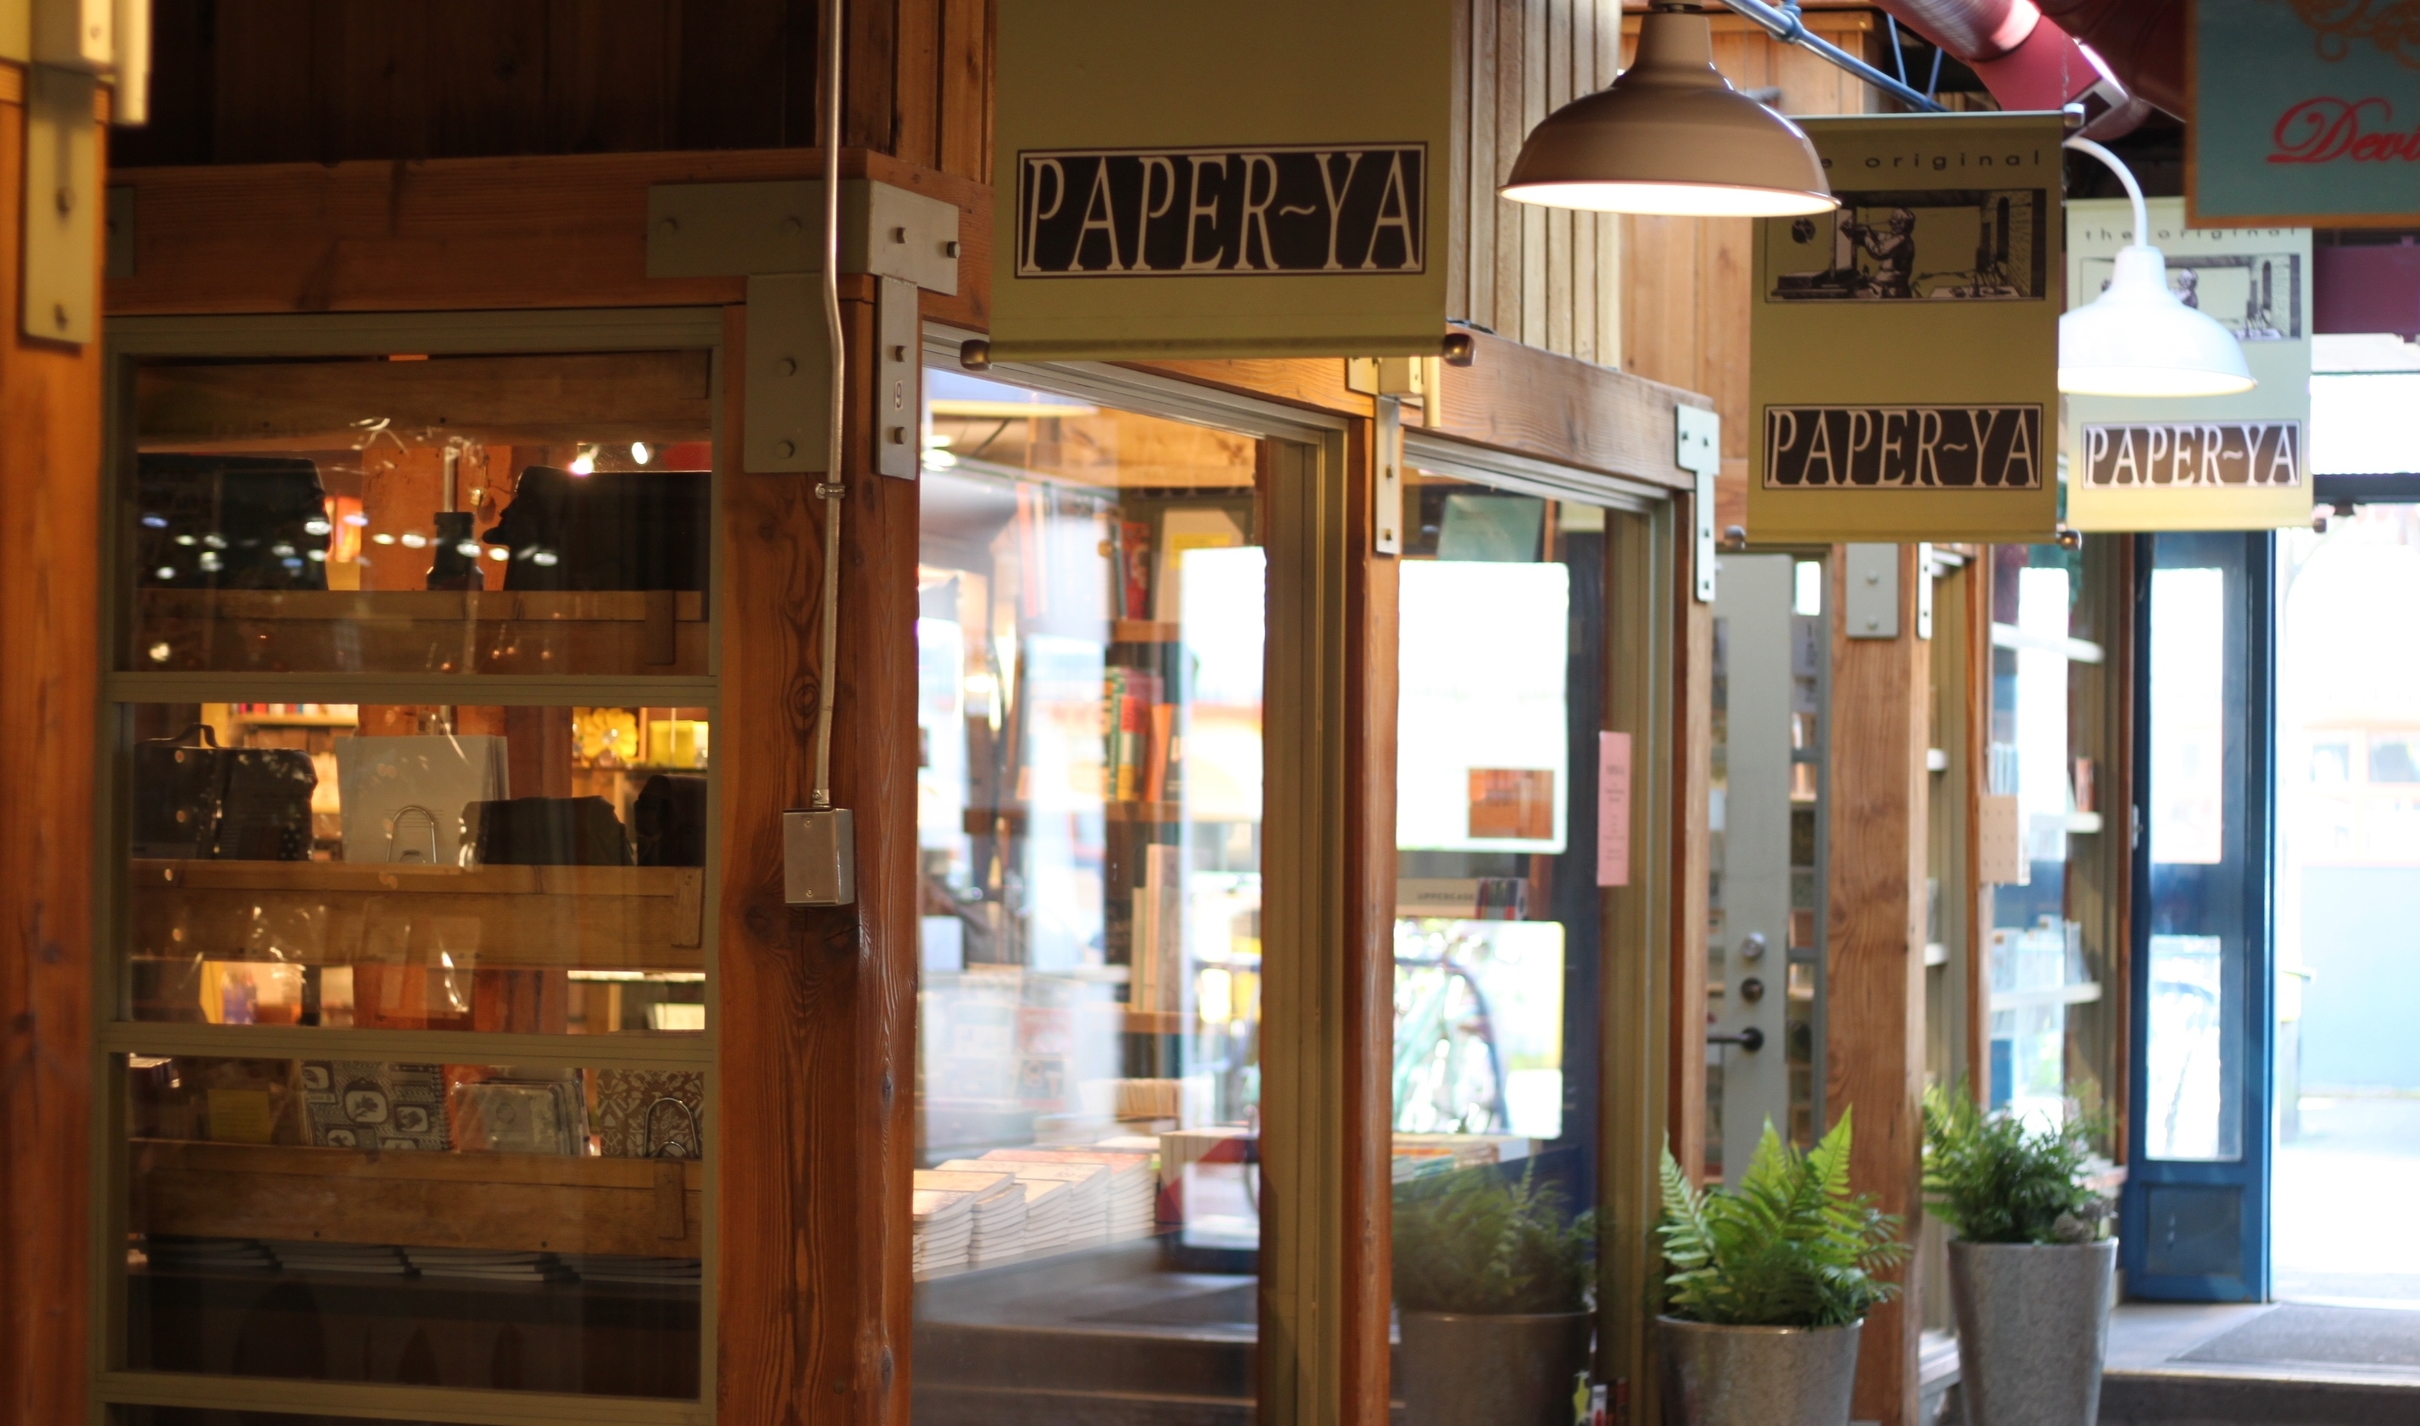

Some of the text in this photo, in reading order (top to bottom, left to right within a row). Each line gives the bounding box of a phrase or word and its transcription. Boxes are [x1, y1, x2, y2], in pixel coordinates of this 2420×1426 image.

[1864, 150, 2040, 171] original
[1021, 150, 1420, 272] PAPER~YA
[1767, 407, 2040, 487] PAPER~YA
[2085, 423, 2299, 486] PAPER~YA
